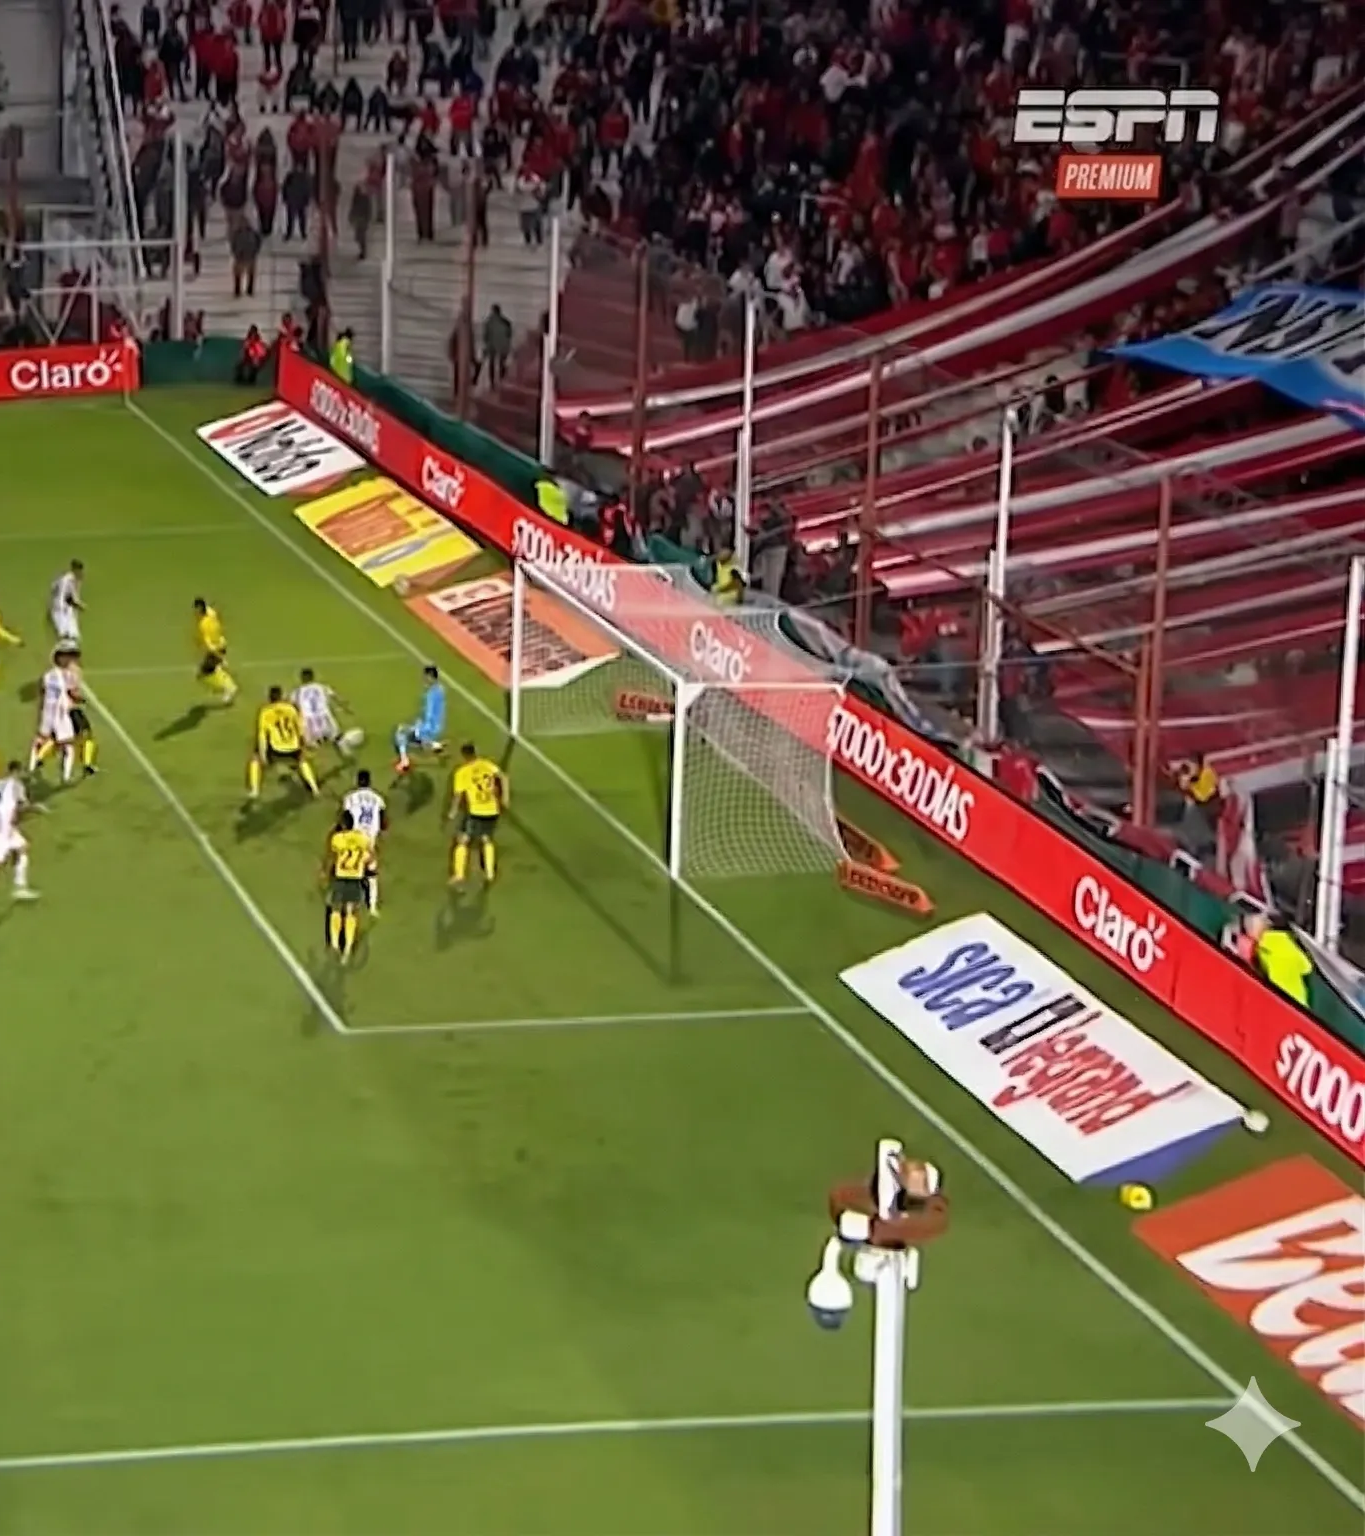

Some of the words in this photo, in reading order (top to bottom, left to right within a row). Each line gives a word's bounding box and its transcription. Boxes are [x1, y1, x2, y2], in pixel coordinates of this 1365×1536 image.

[11, 350, 117, 391] Claro
[690, 620, 750, 683] Claro
[1075, 876, 1165, 972] Claro
[993, 1011, 1193, 1137] legrand
